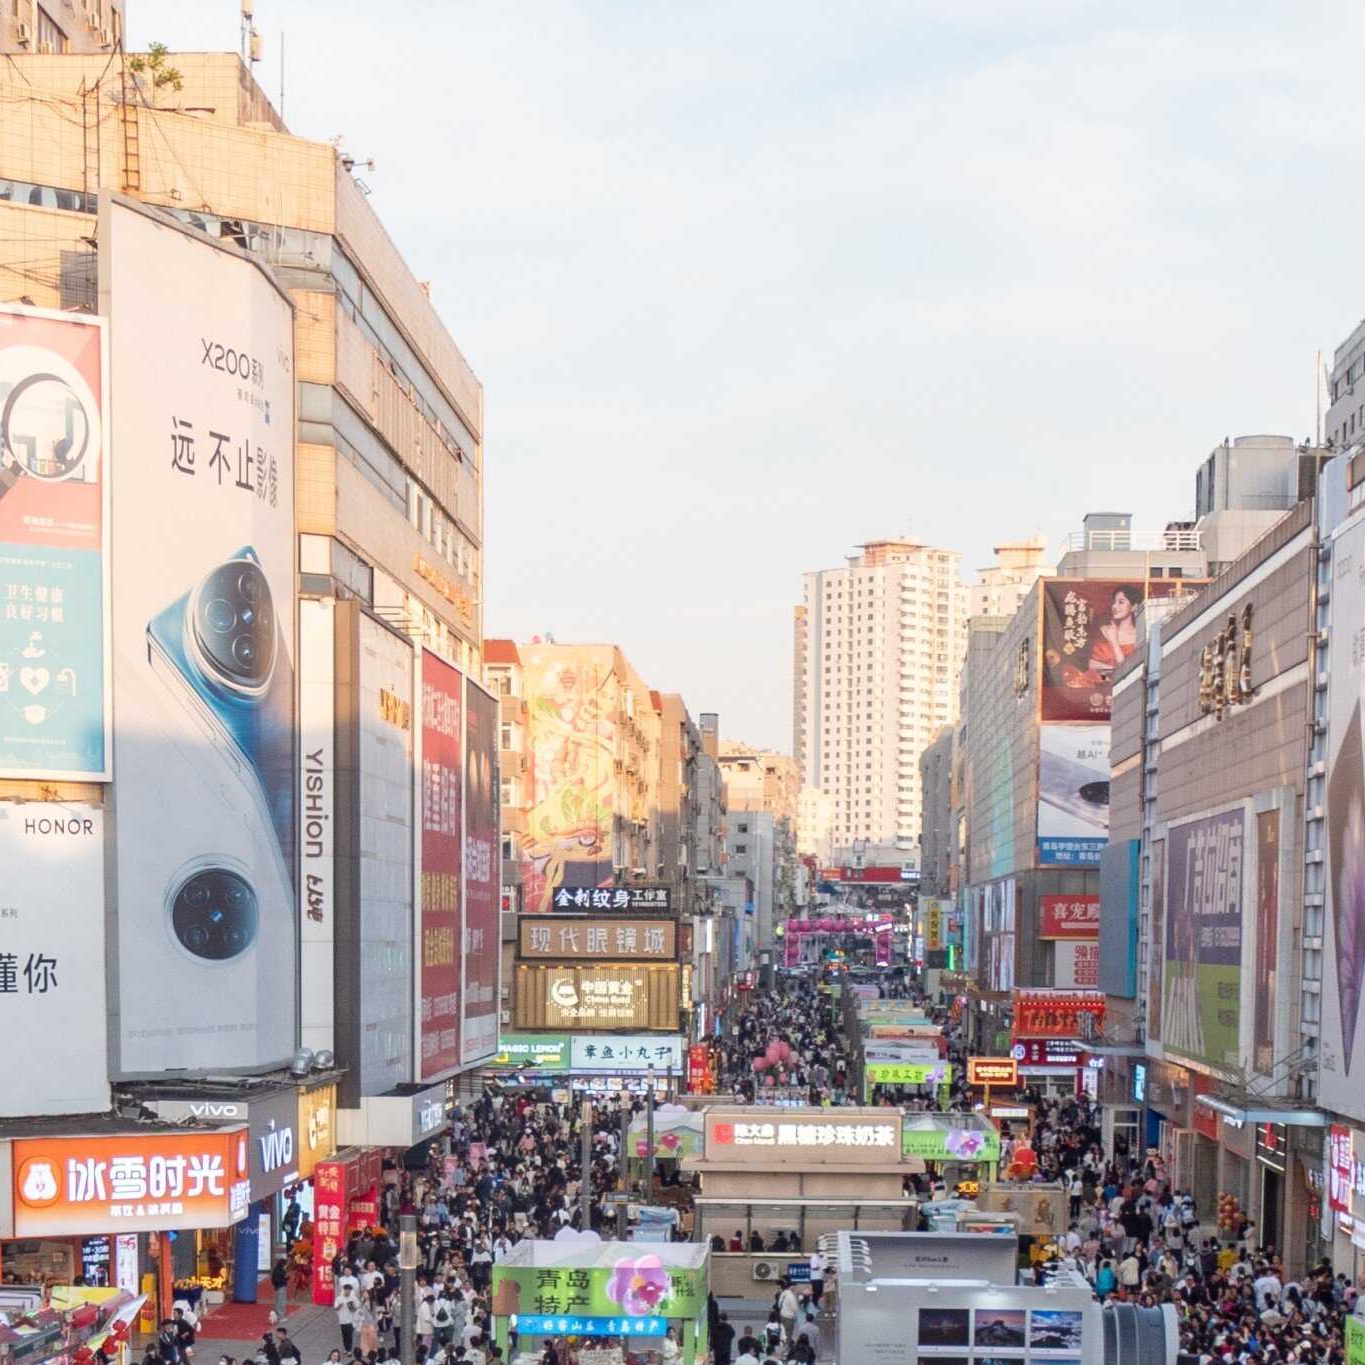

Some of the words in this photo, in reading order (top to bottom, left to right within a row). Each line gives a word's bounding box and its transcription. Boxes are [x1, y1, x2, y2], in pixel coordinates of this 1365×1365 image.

[25, 818, 94, 836] HONOR
[530, 926, 665, 953] 现代眼镜城
[584, 1044, 671, 1060] 章鱼小丸子
[189, 1103, 239, 1117] vivo
[260, 1117, 293, 1173] vivo
[776, 1123, 895, 1146] 黑糖珍珠奶茶
[67, 1153, 226, 1202] 冰雪时光
[536, 1269, 590, 1289] 青岛
[535, 1294, 590, 1315] 特产
